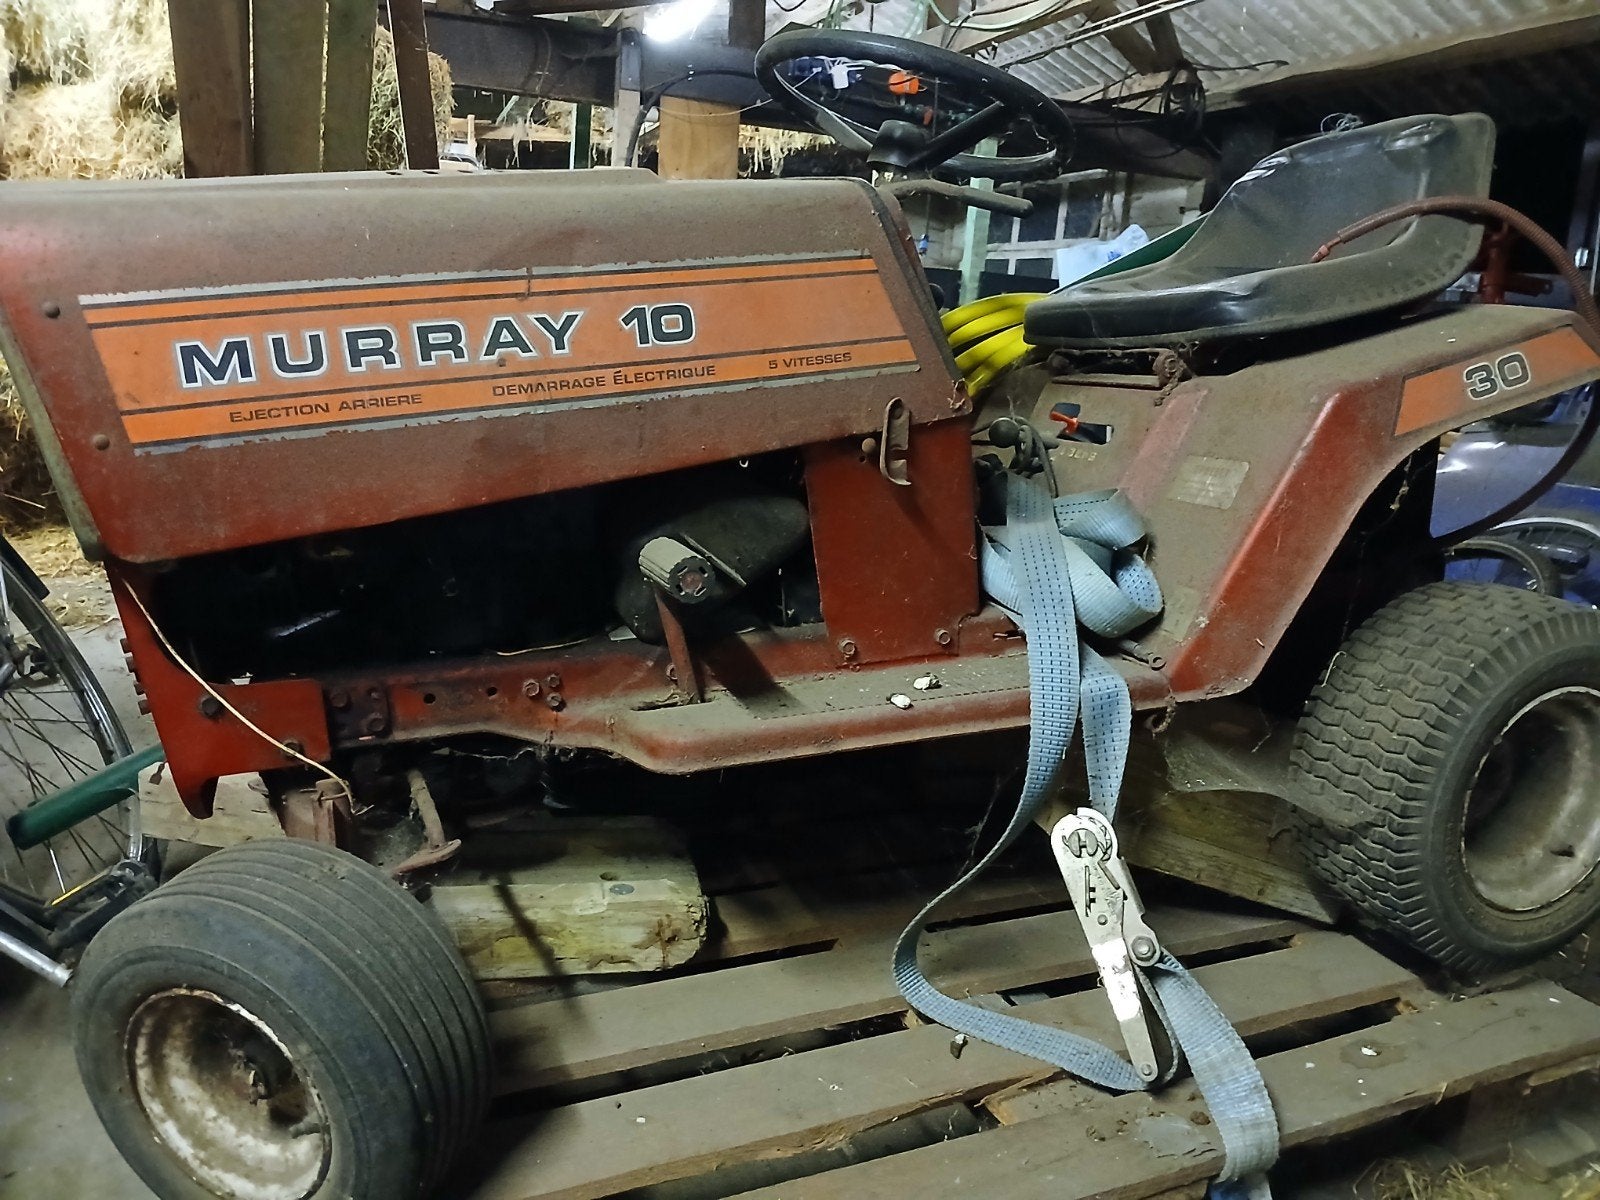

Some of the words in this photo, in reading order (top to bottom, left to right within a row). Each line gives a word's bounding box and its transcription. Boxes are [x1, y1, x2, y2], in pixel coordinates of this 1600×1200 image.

[176, 310, 583, 388] MURRAY
[619, 303, 696, 348] 10
[768, 359, 779, 370] 5
[782, 351, 853, 369] VITESSES
[492, 376, 606, 397] DEMARRAGE
[613, 365, 716, 385] ÉLECTRIQUE
[1464, 351, 1531, 400] 30
[229, 402, 330, 423] EJECTION
[338, 393, 423, 412] ARRIERE
